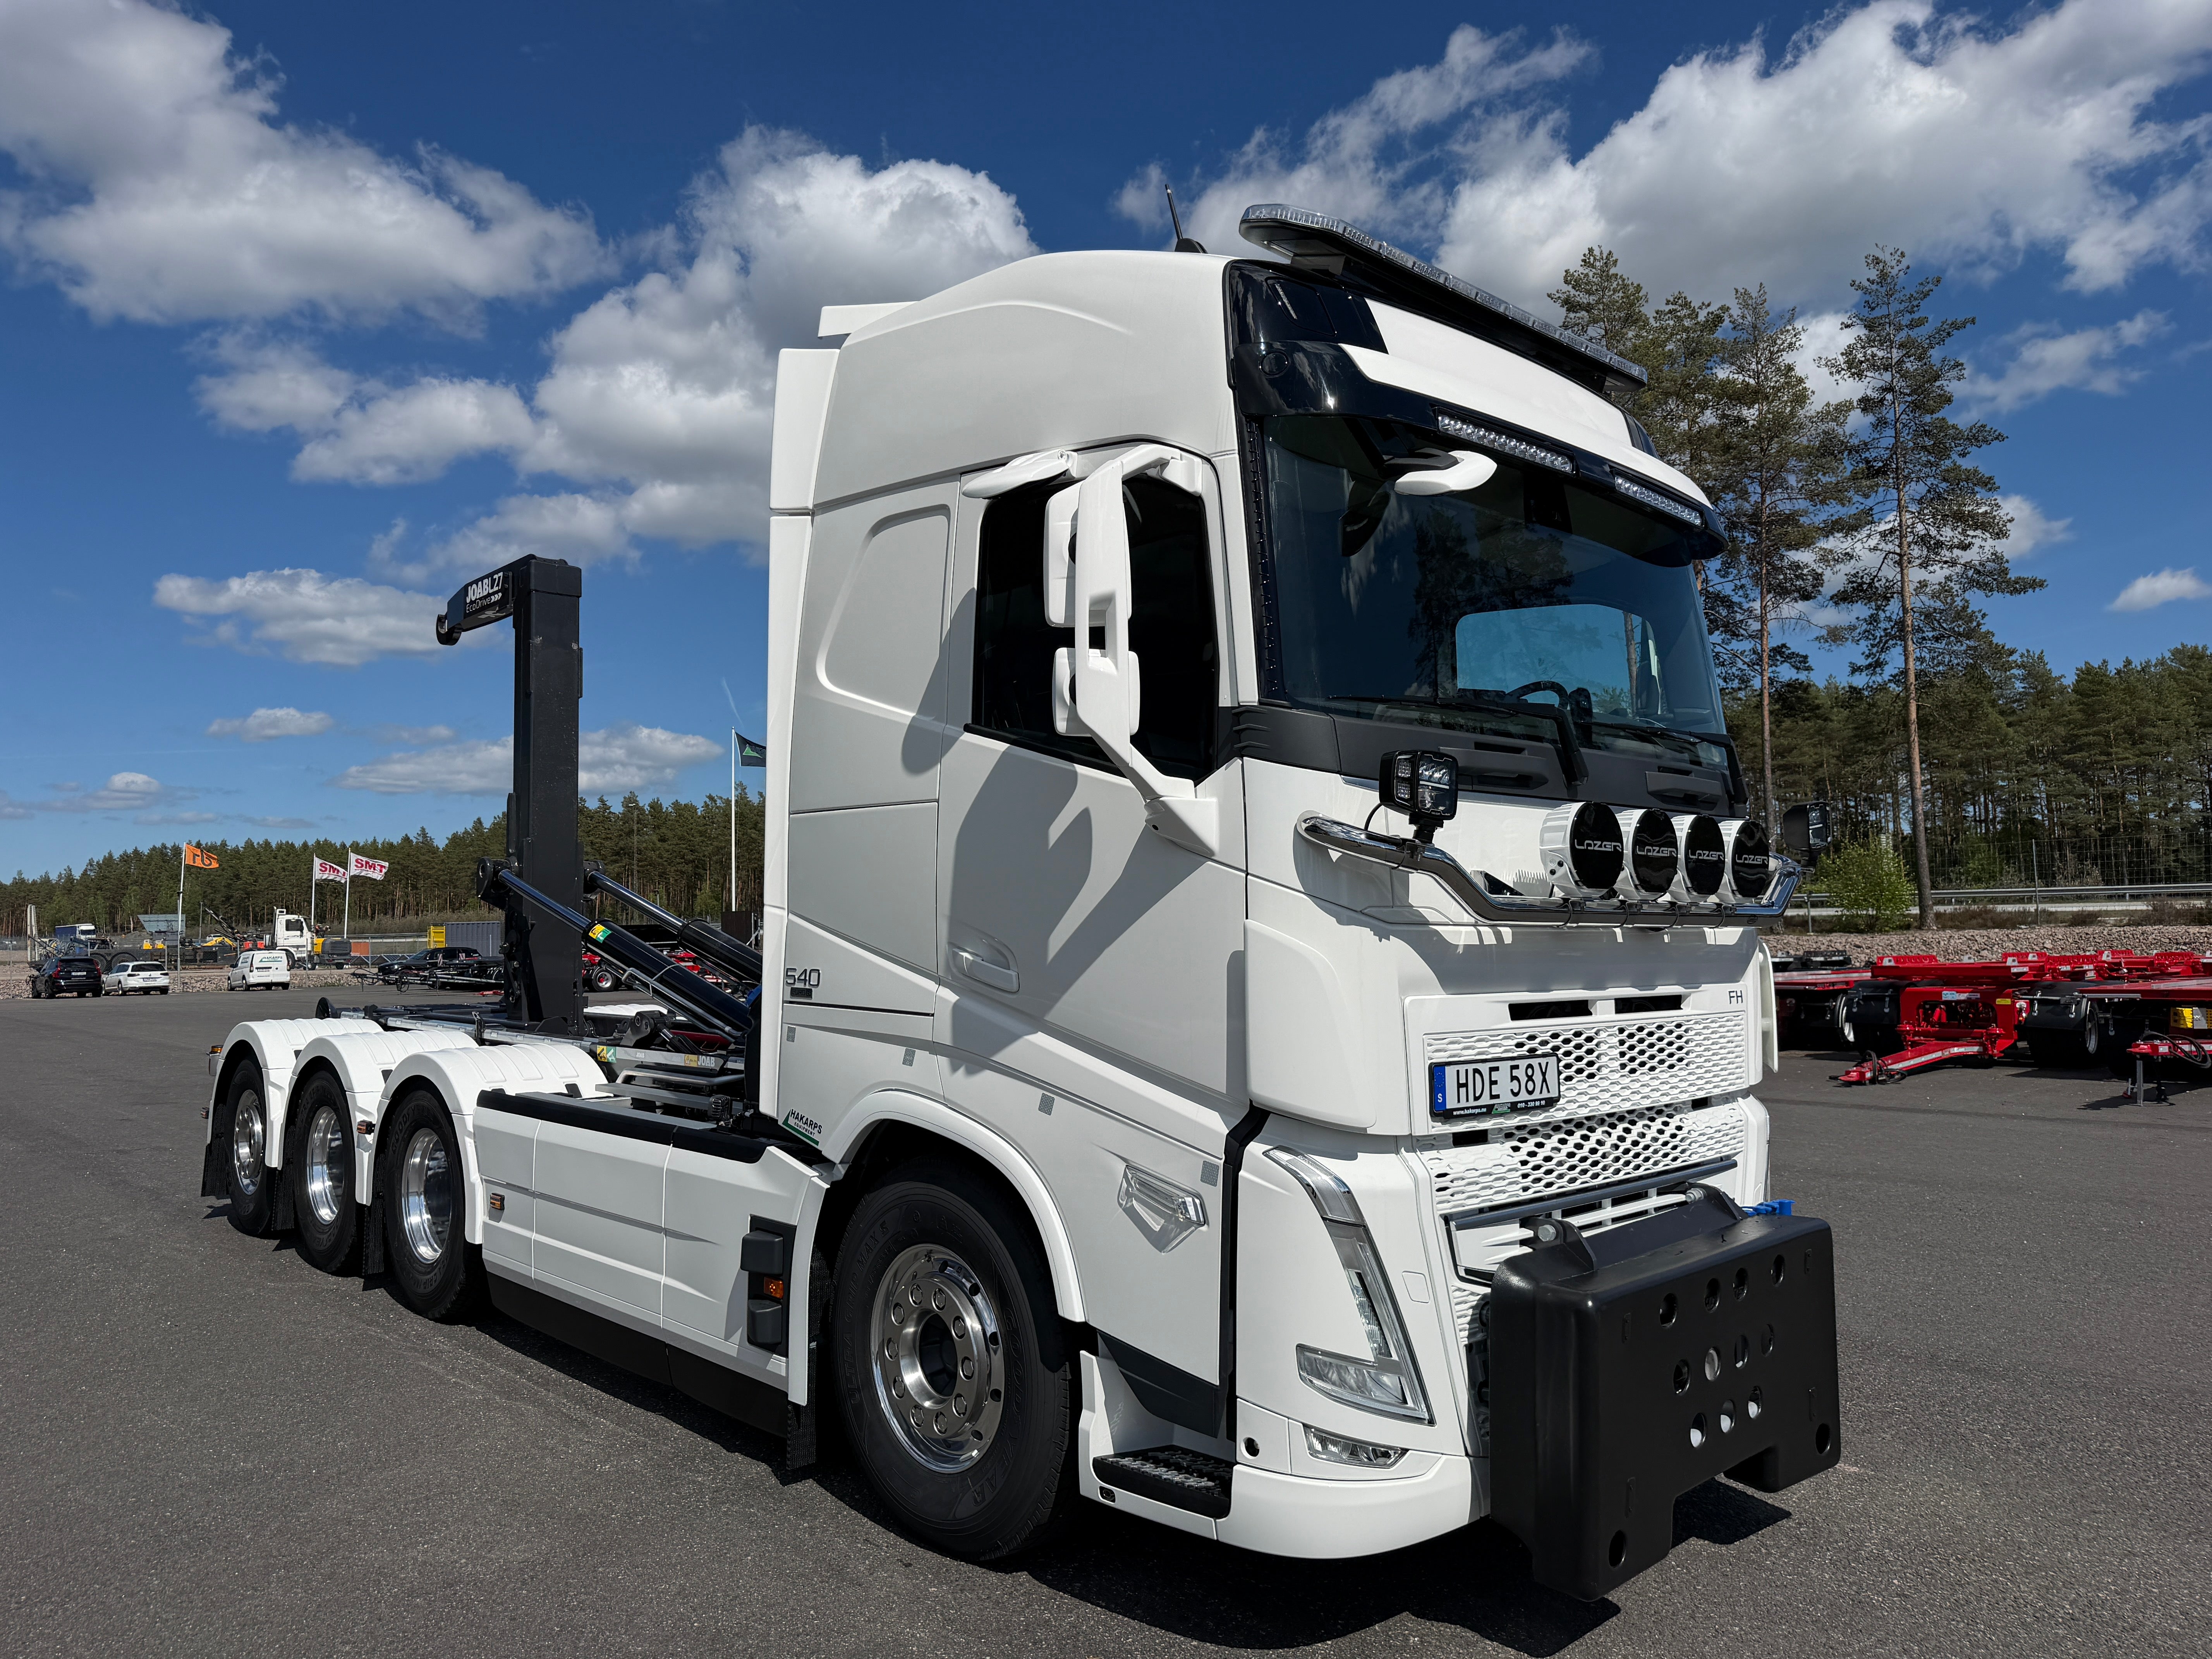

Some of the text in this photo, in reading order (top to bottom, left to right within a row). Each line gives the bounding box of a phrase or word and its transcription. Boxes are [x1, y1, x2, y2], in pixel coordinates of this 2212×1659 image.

[466, 598, 491, 613] EcoDrive
[1575, 839, 1622, 852] LAZER
[1637, 845, 1677, 857] LAZER
[1689, 849, 1724, 860] LAZER
[1736, 854, 1768, 865] LAZER
[354, 858, 386, 873] SMT
[785, 968, 821, 988] 540
[1728, 990, 1743, 1005] FH
[697, 1055, 715, 1067] JOAB
[1456, 1061, 1550, 1103] HDE 58X
[1437, 1093, 1443, 1103] S
[790, 1108, 823, 1134] HAKARPS
[794, 1121, 815, 1137] EQUIPMENT
